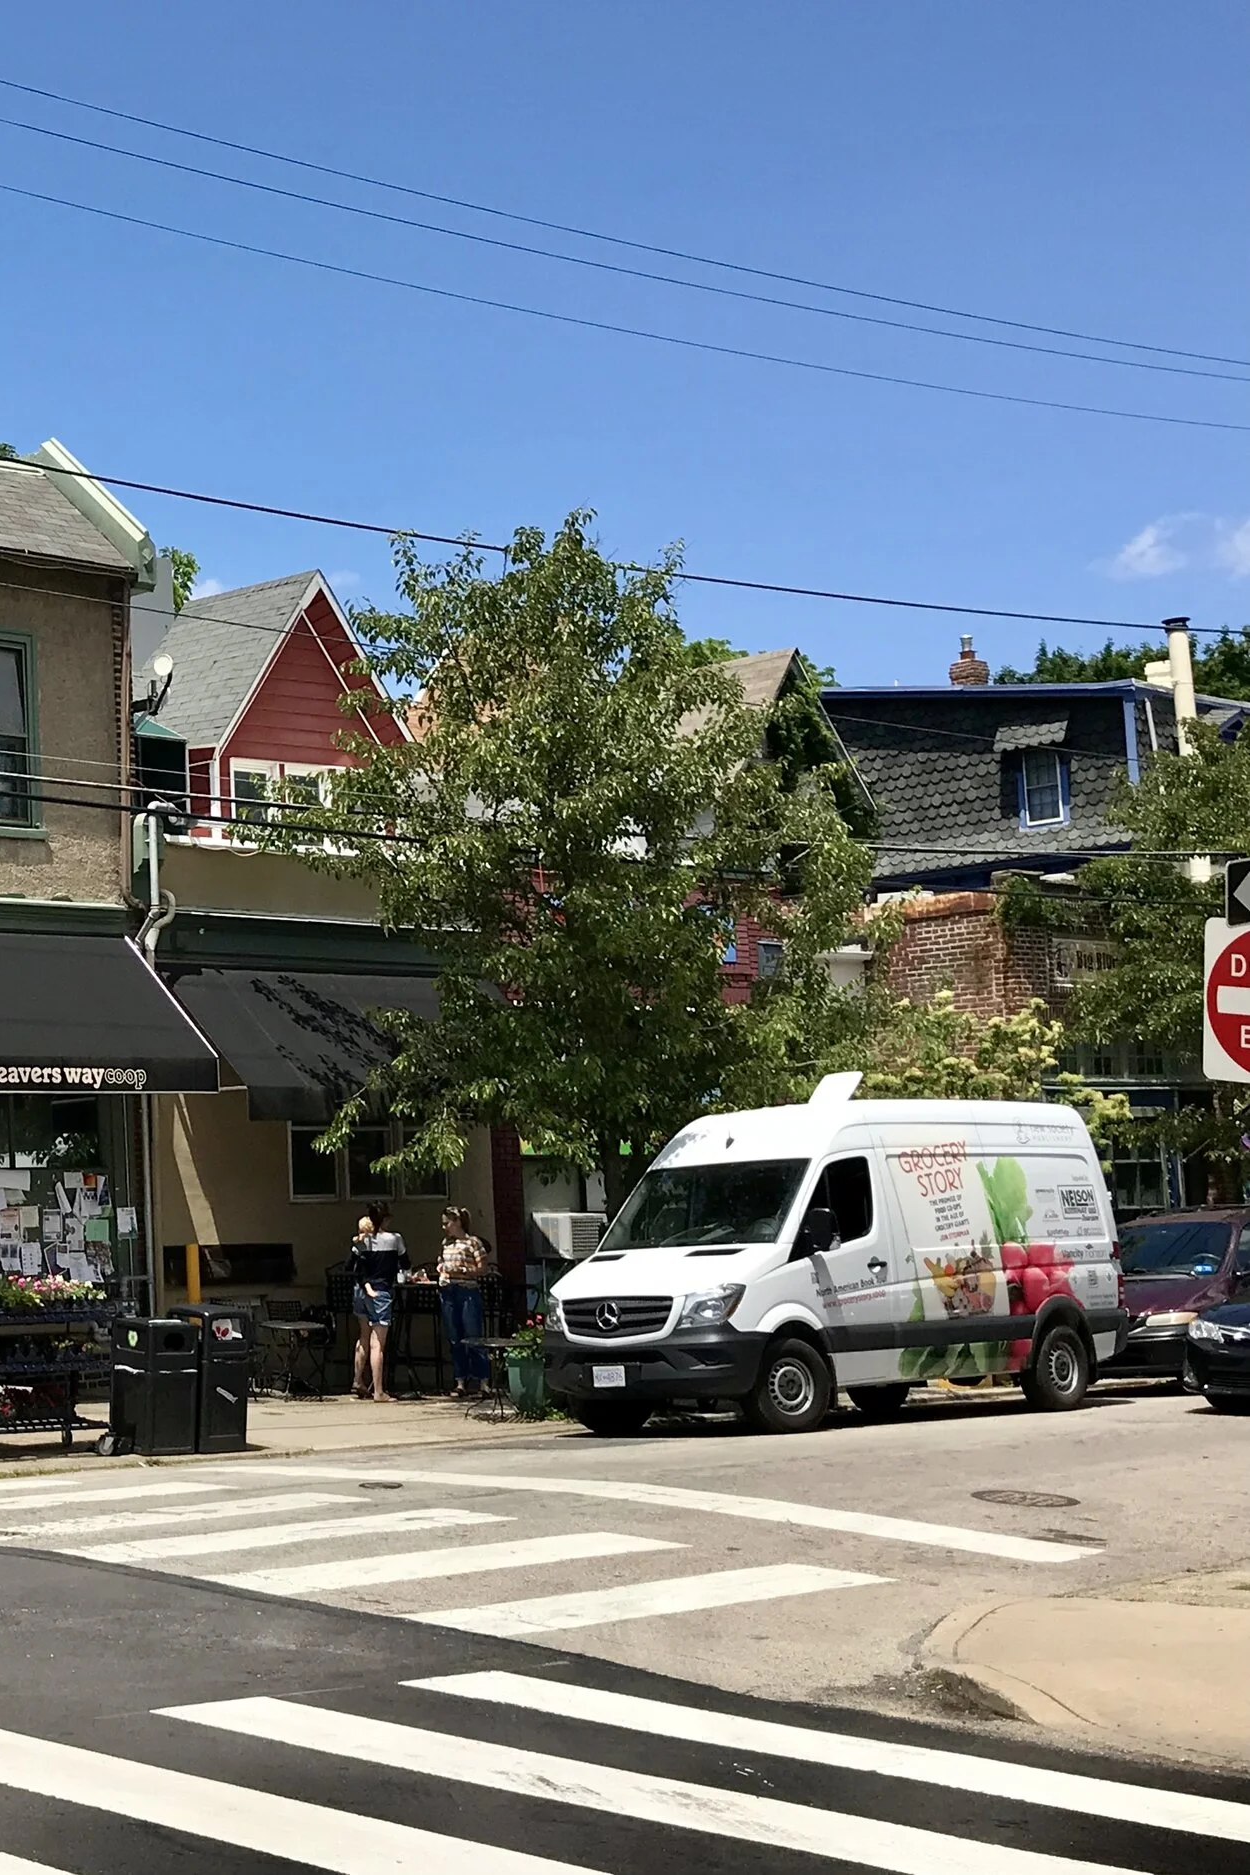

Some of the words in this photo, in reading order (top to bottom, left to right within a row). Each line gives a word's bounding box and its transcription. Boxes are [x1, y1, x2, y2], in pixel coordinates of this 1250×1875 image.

[1076, 951, 1094, 972] Big
[897, 1140, 968, 1174] GROCERY
[917, 1167, 964, 1197] STORY
[1060, 1189, 1094, 1207] NELSON
[816, 1287, 832, 1297] North
[834, 1282, 859, 1294] American
[860, 1278, 875, 1288] Book
